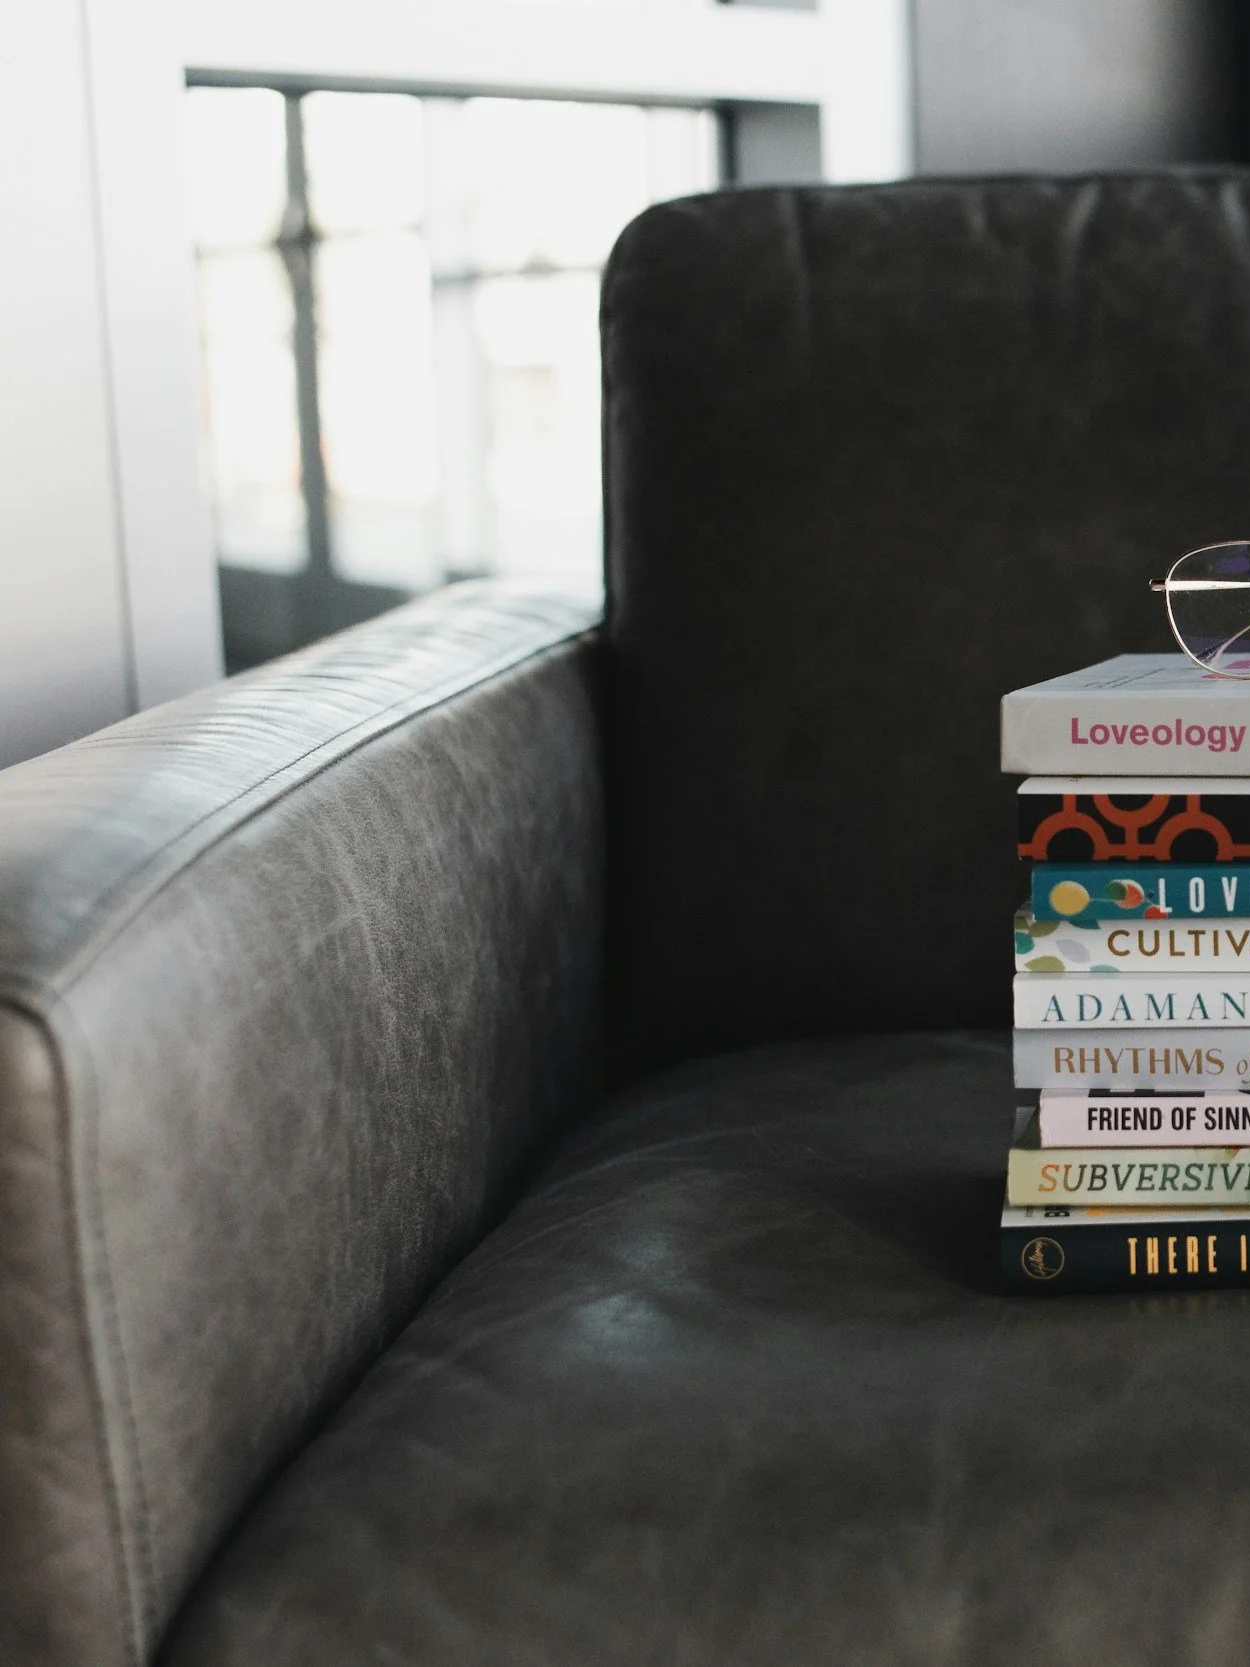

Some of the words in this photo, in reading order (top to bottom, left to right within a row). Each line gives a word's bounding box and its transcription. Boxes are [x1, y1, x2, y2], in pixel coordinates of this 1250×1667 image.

[1071, 717, 1246, 752] Loveology
[1053, 1047, 1225, 1075] RHYTHMS
[1087, 1107, 1163, 1131] FRIEND
[1171, 1107, 1197, 1130] OF
[1127, 1234, 1218, 1275] THERE
